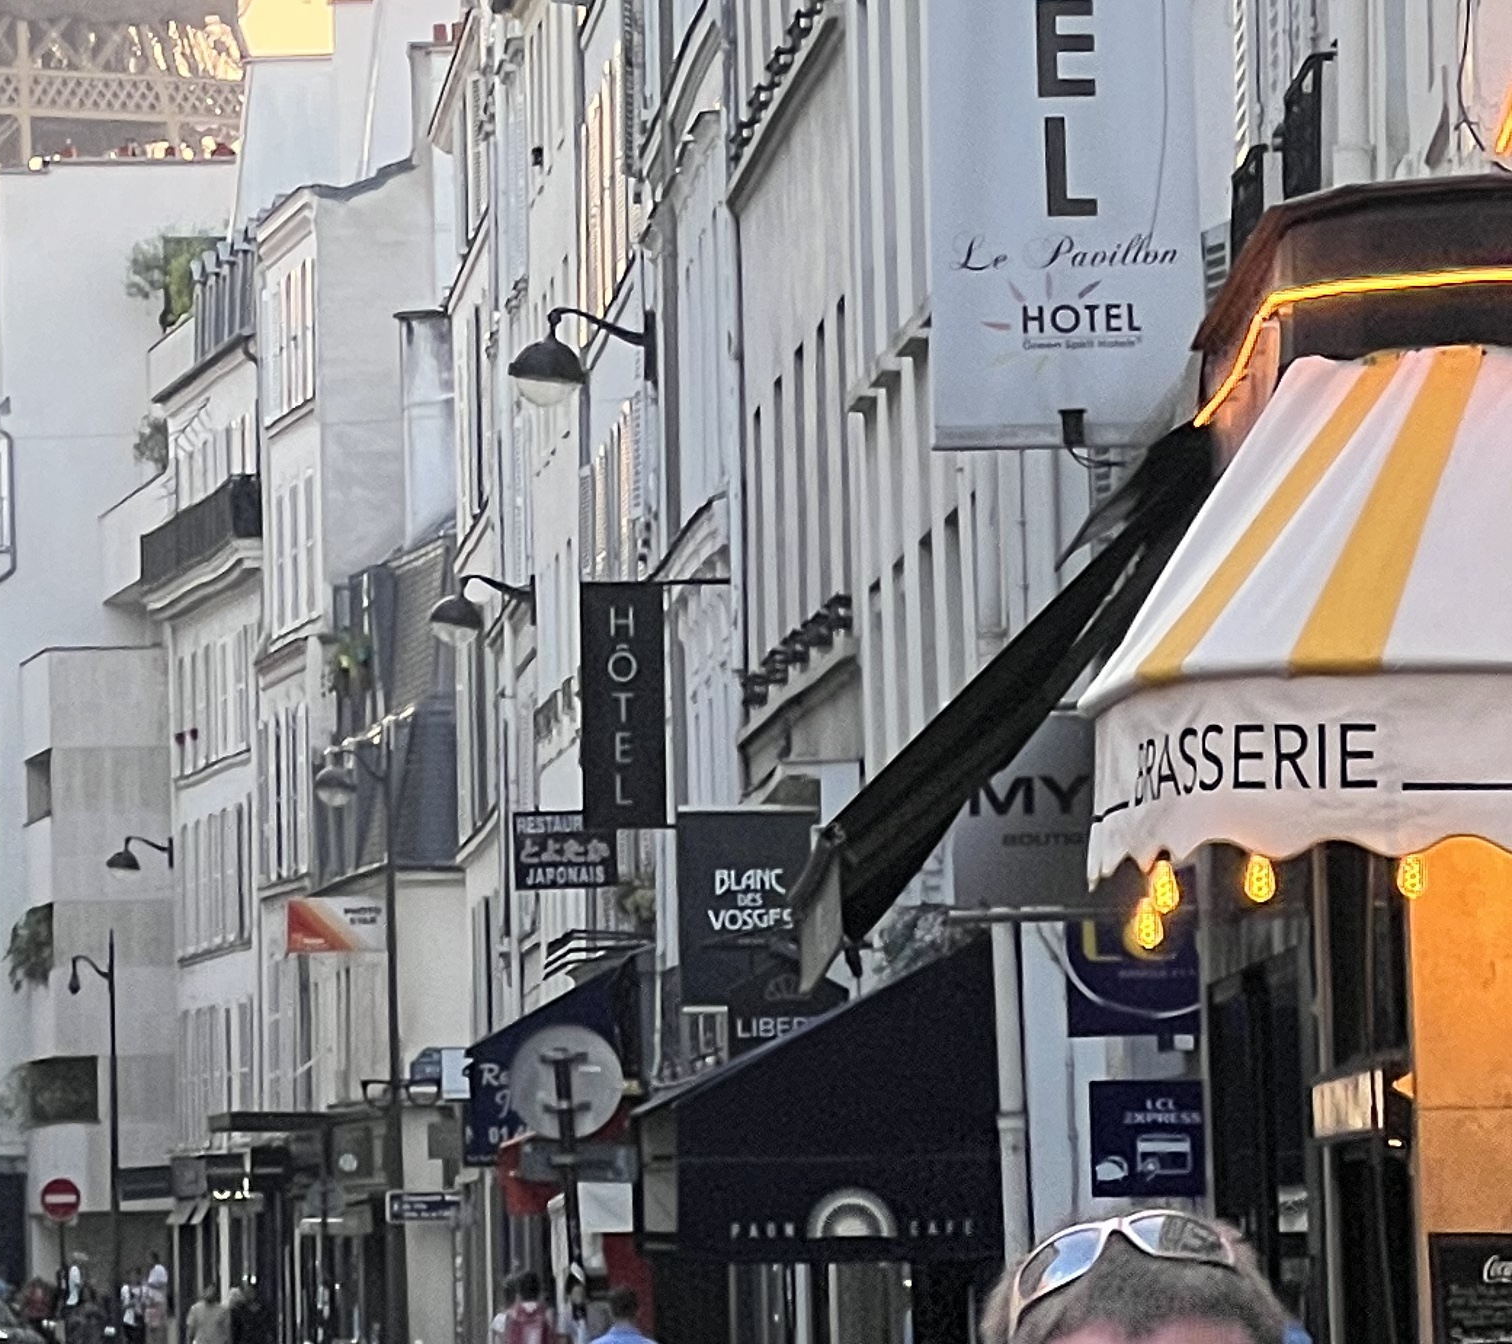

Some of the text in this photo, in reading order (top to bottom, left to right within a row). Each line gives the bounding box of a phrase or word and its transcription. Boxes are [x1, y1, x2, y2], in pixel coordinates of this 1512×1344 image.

[950, 229, 1178, 271] Le Pavillon
[1022, 303, 1142, 334] HOTEL
[1135, 723, 1378, 807] BRASSERIE
[525, 865, 606, 885] JAPONAIS
[715, 868, 786, 895] BLANC
[737, 892, 764, 907] DES
[1123, 1111, 1202, 1124] EXPRESS
